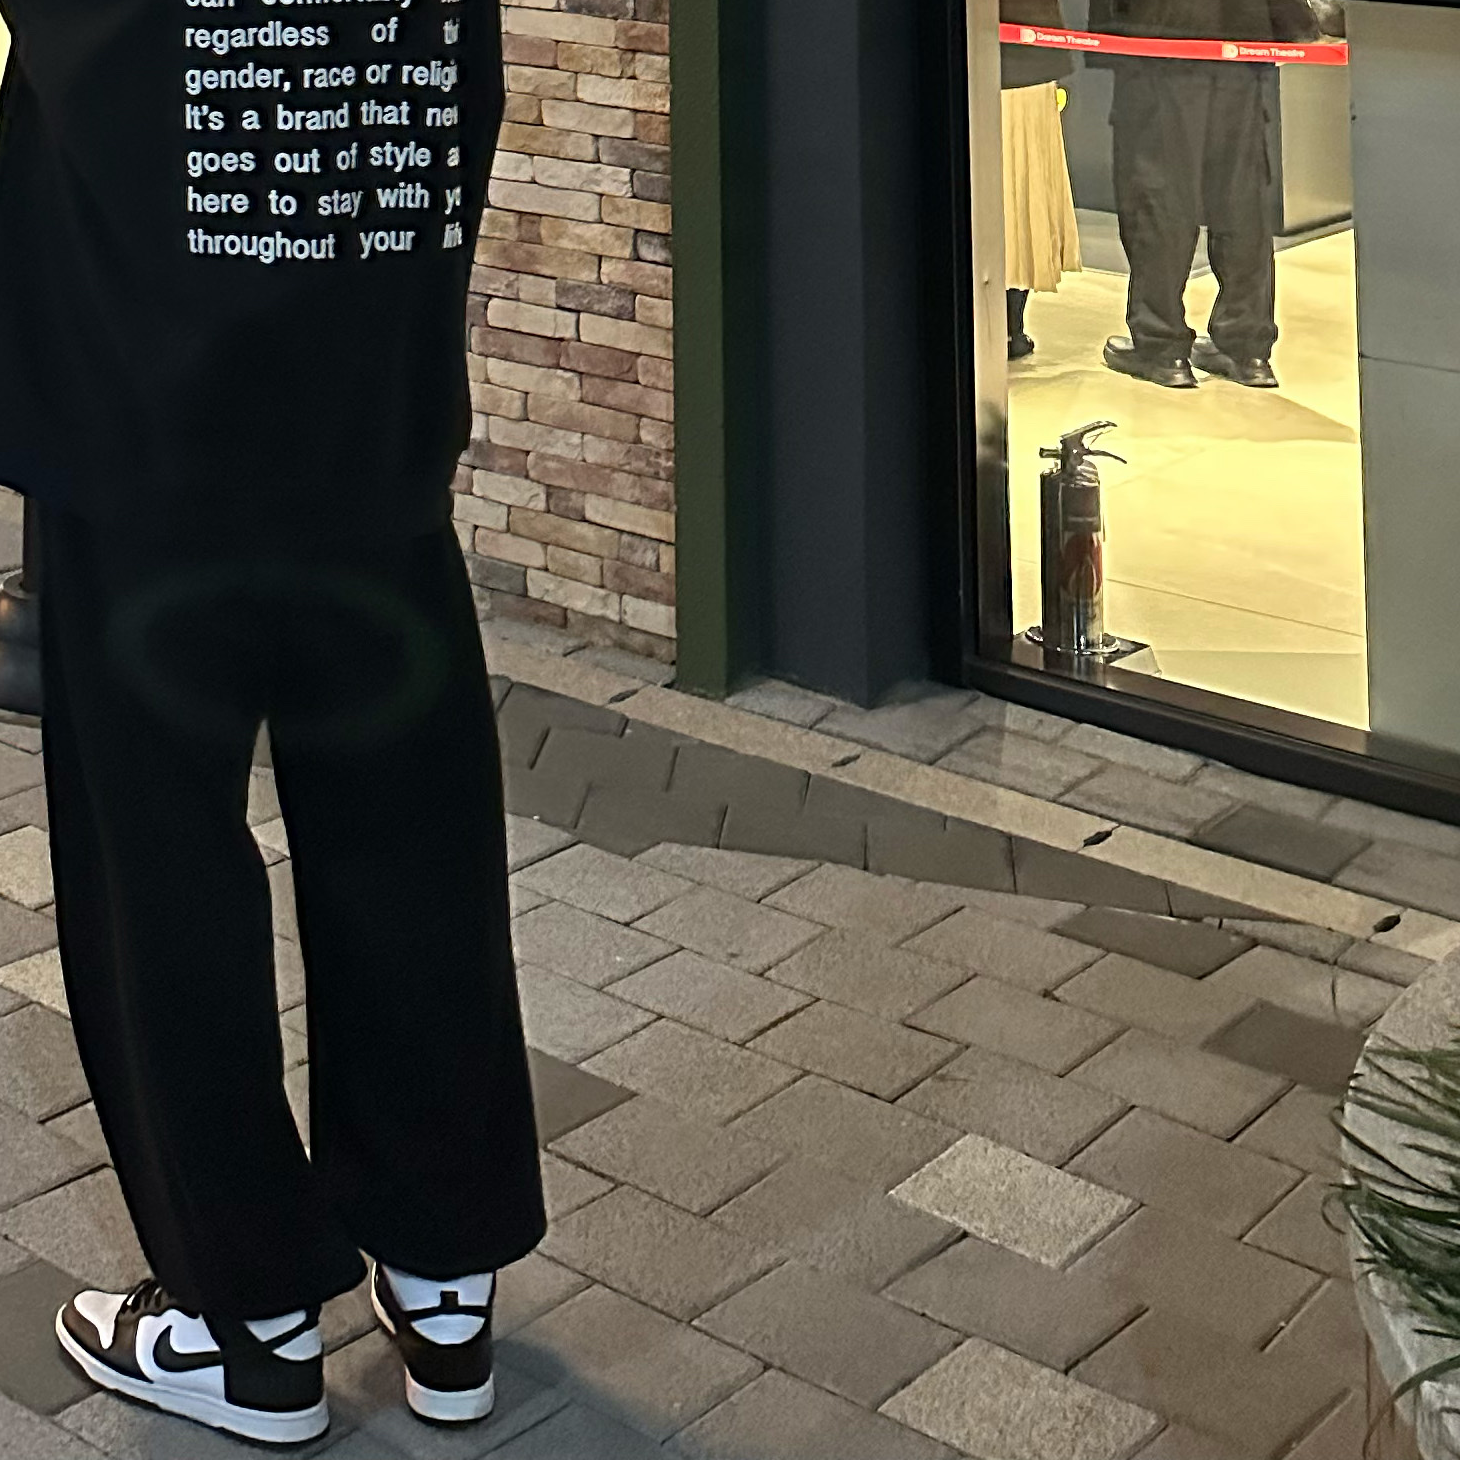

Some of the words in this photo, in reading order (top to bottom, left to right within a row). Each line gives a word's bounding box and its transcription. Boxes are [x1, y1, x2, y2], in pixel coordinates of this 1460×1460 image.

[185, 20, 330, 56] regardless
[371, 16, 399, 43] of
[184, 61, 291, 96] gender,
[302, 65, 356, 89] race
[365, 64, 392, 85] or
[184, 103, 225, 131] It's
[241, 109, 262, 131] a
[276, 101, 350, 131] brand
[360, 99, 411, 126] that
[186, 150, 256, 178] goes
[274, 148, 321, 174] out
[336, 141, 358, 171] of
[369, 140, 432, 173] style
[187, 185, 250, 214] here
[267, 189, 298, 216] to
[317, 189, 364, 218] stay
[375, 181, 430, 209] with
[186, 228, 336, 264] throughout
[359, 230, 416, 260] your
